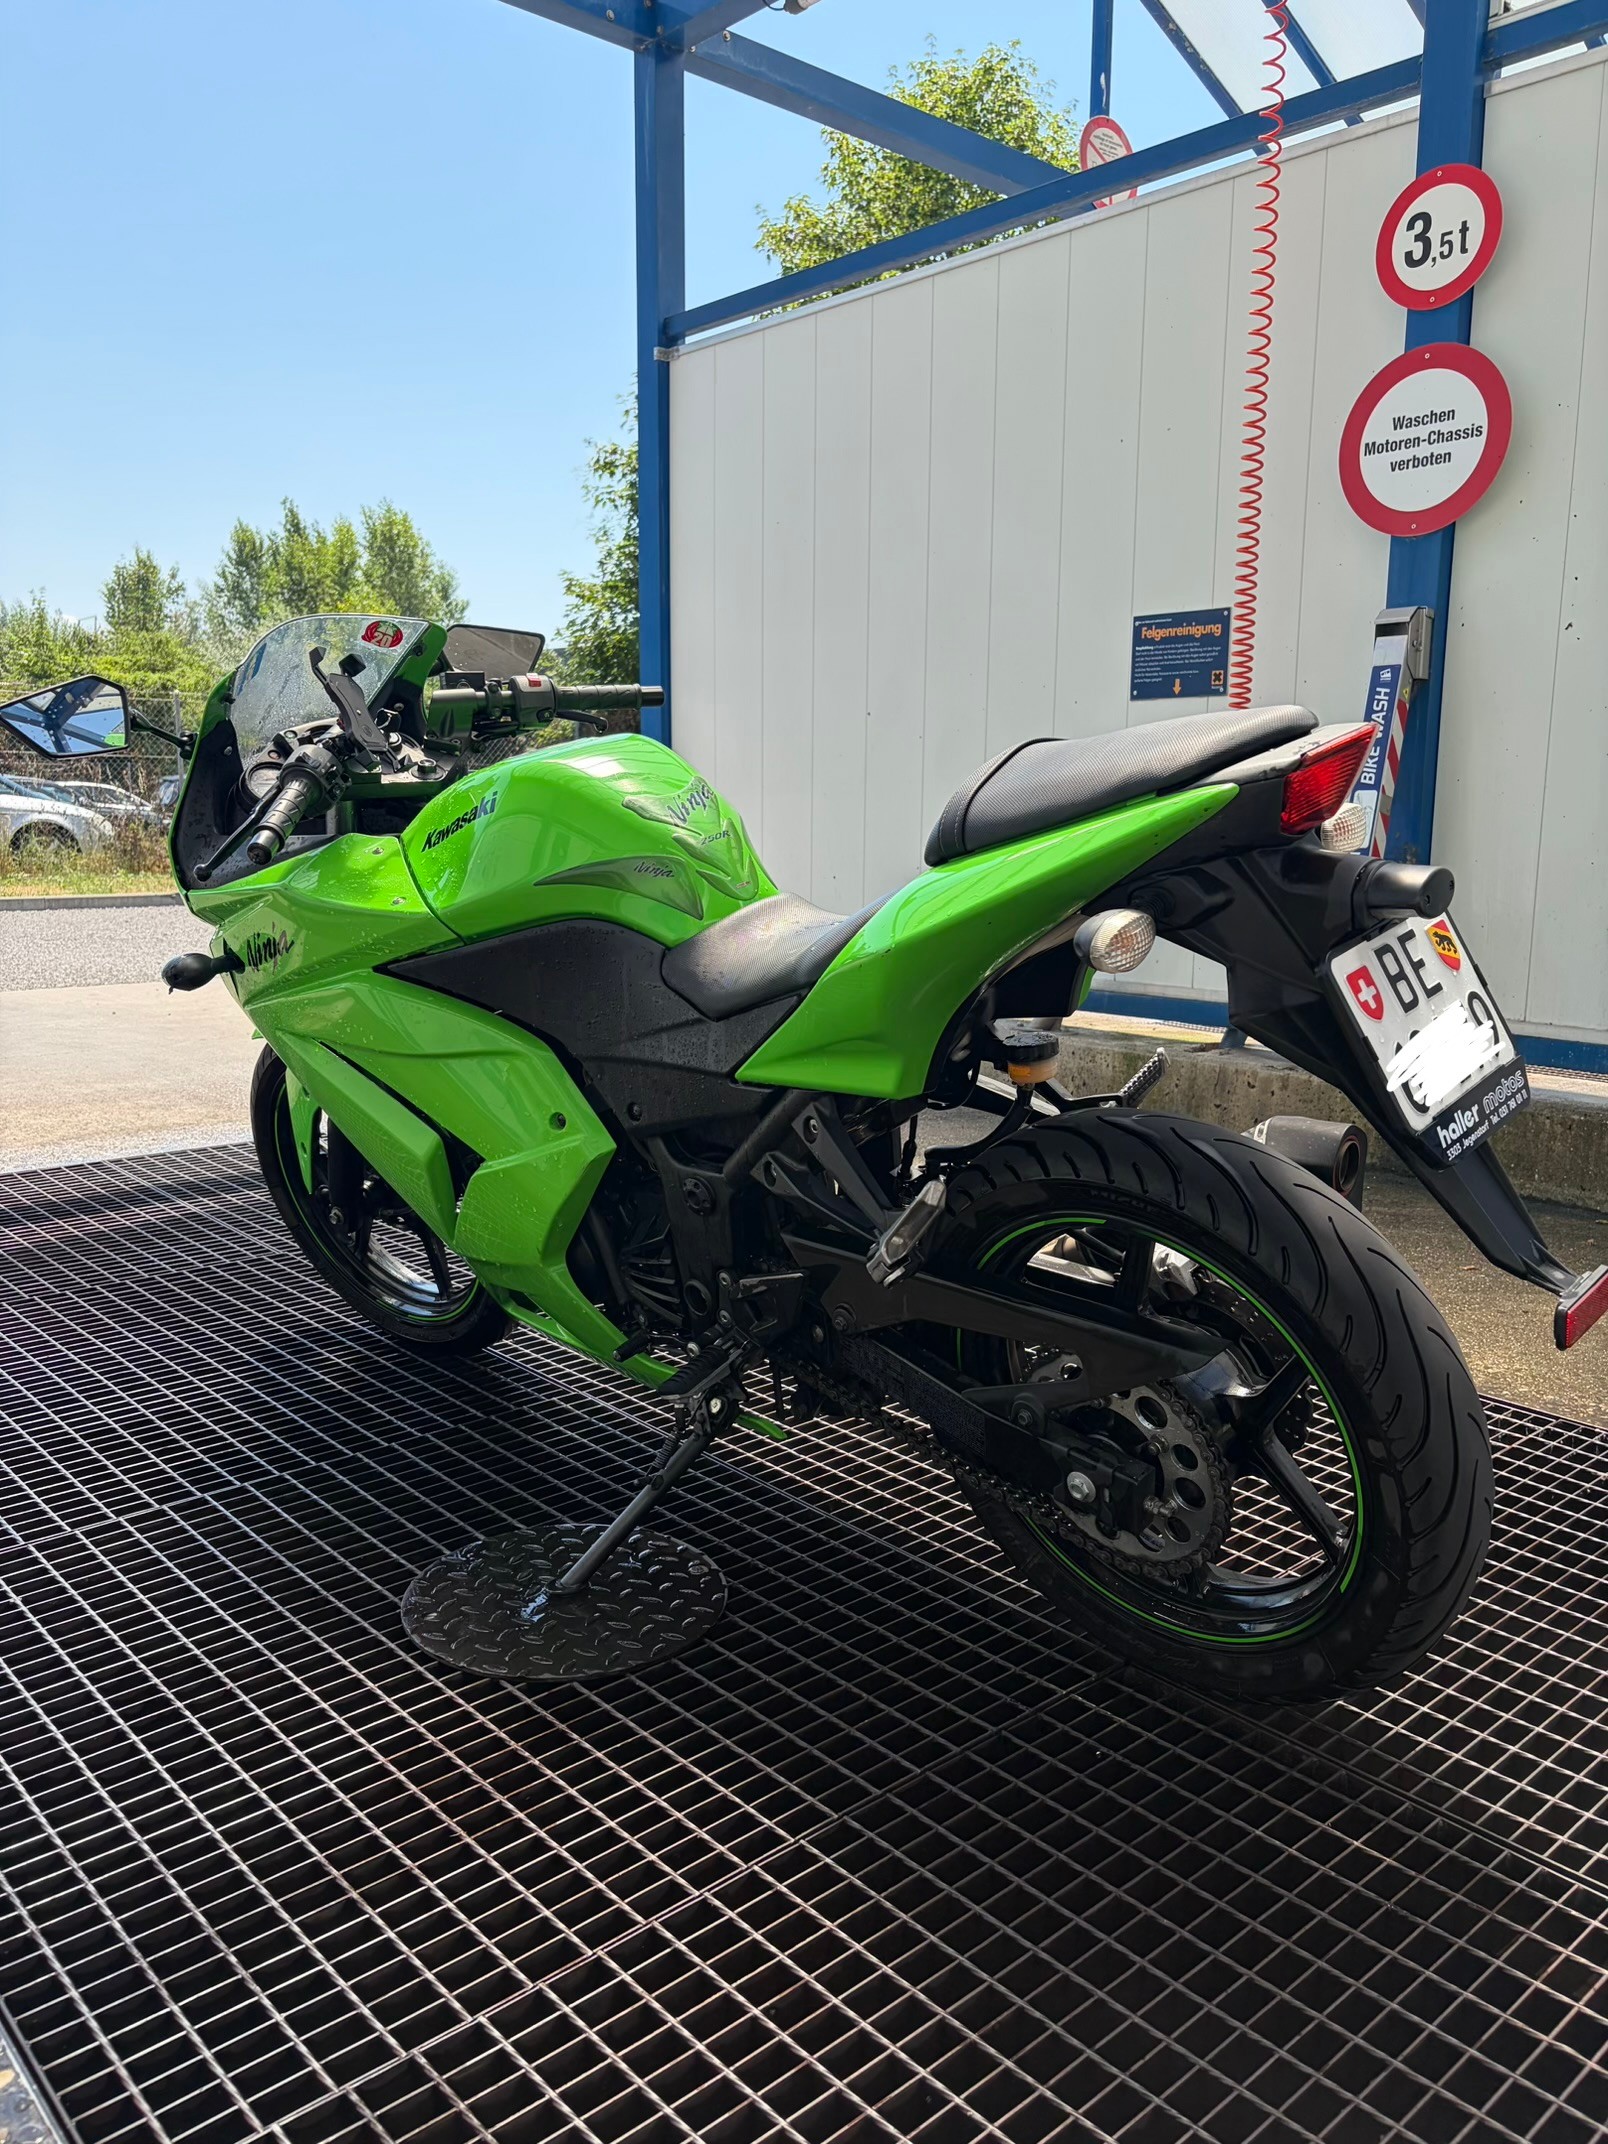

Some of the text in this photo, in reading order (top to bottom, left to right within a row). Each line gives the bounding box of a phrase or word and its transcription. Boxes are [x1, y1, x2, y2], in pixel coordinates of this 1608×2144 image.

[1392, 408, 1456, 432] Waschen
[1363, 423, 1484, 458] Motoren-Chassis
[1389, 450, 1452, 473] verboten
[1141, 621, 1222, 641] Felgenreinigung
[421, 790, 499, 853] Kawasaki
[667, 783, 715, 825] Ninja
[701, 830, 731, 846] 250R
[634, 861, 675, 878] Ninja
[246, 921, 295, 976] Ninja
[1373, 928, 1444, 1014] BE
[1436, 1069, 1525, 1149] haller motos
